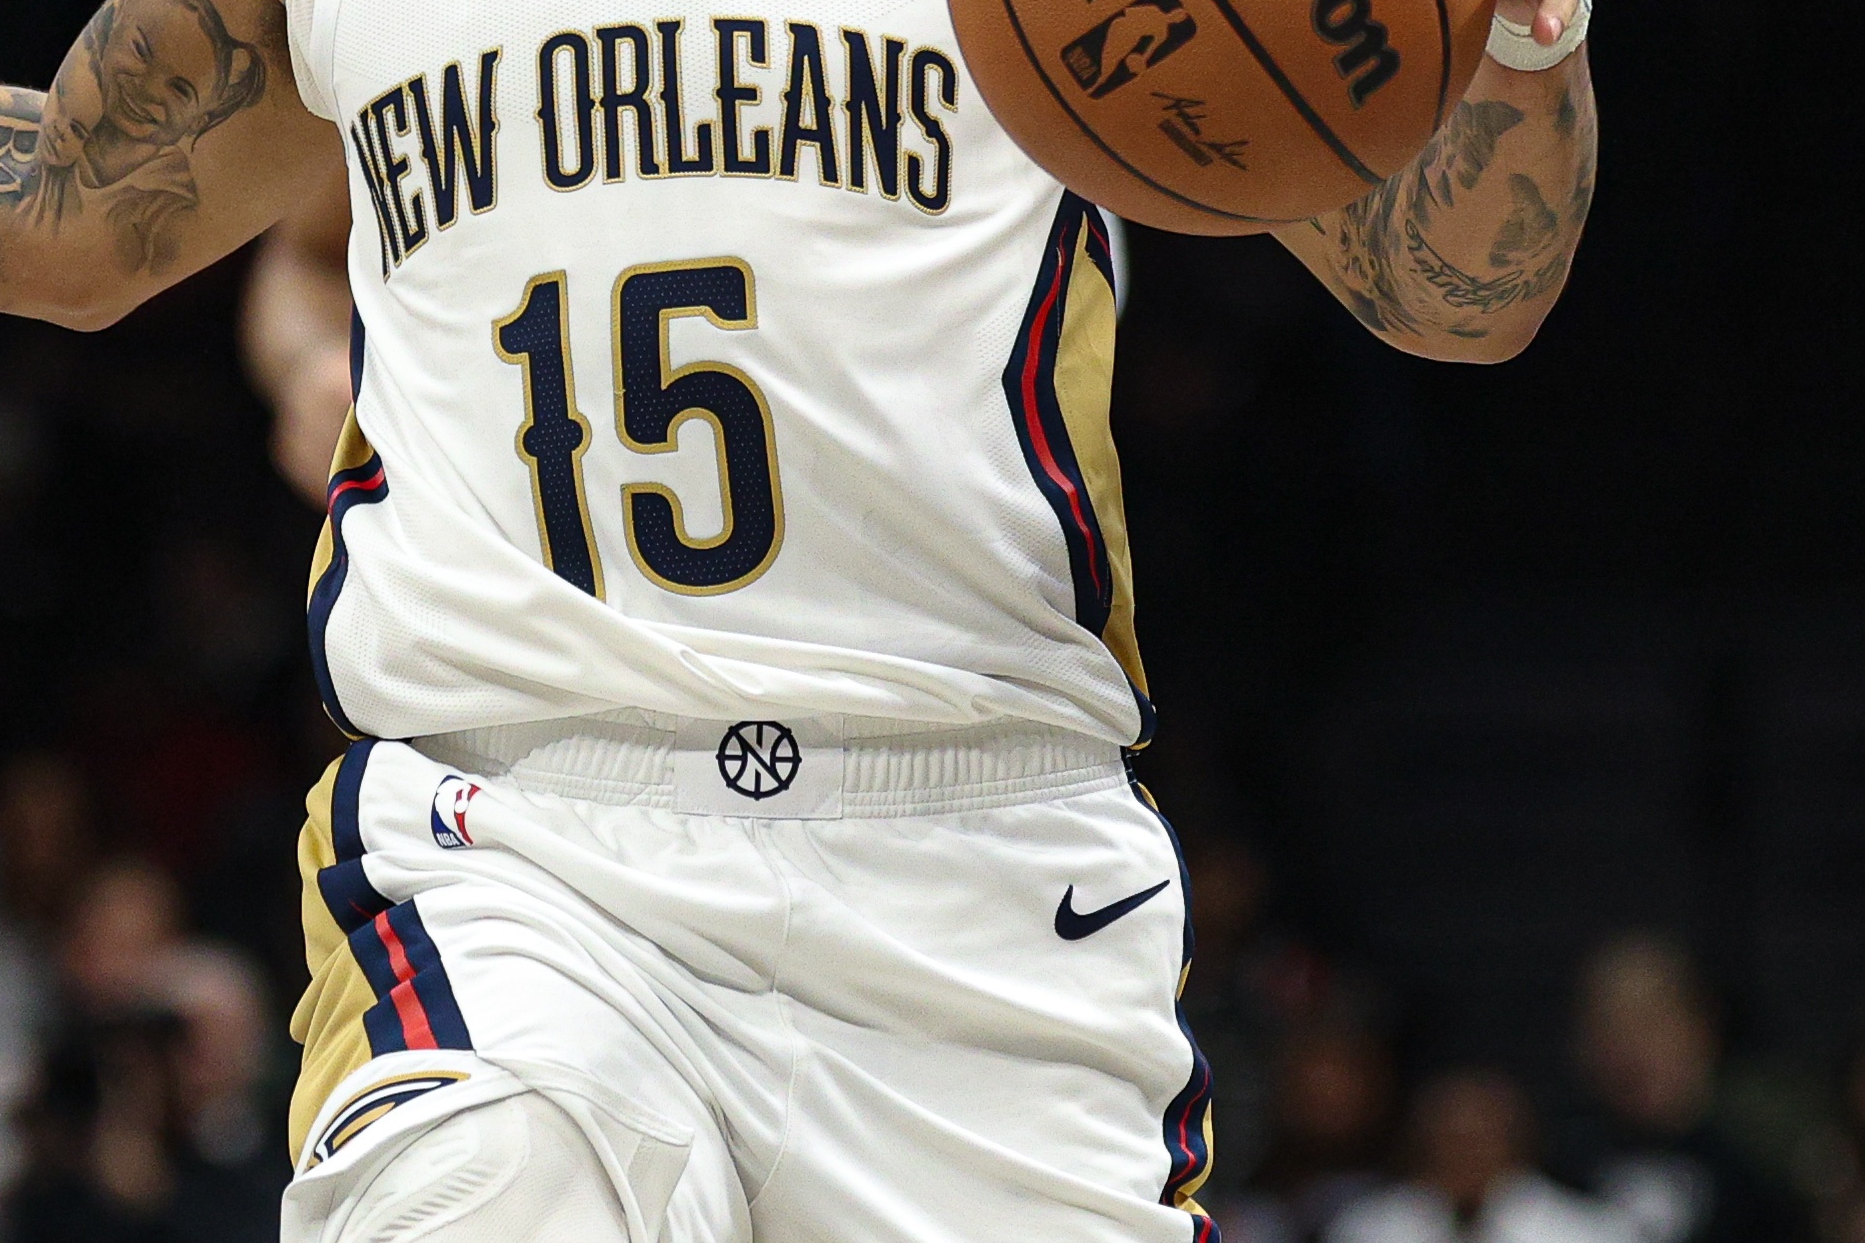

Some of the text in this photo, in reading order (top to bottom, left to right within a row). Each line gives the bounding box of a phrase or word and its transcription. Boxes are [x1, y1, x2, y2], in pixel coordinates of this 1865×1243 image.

[350, 14, 959, 285] NEW ORLEANS
[491, 255, 786, 604] 15
[436, 832, 461, 847] NBA
